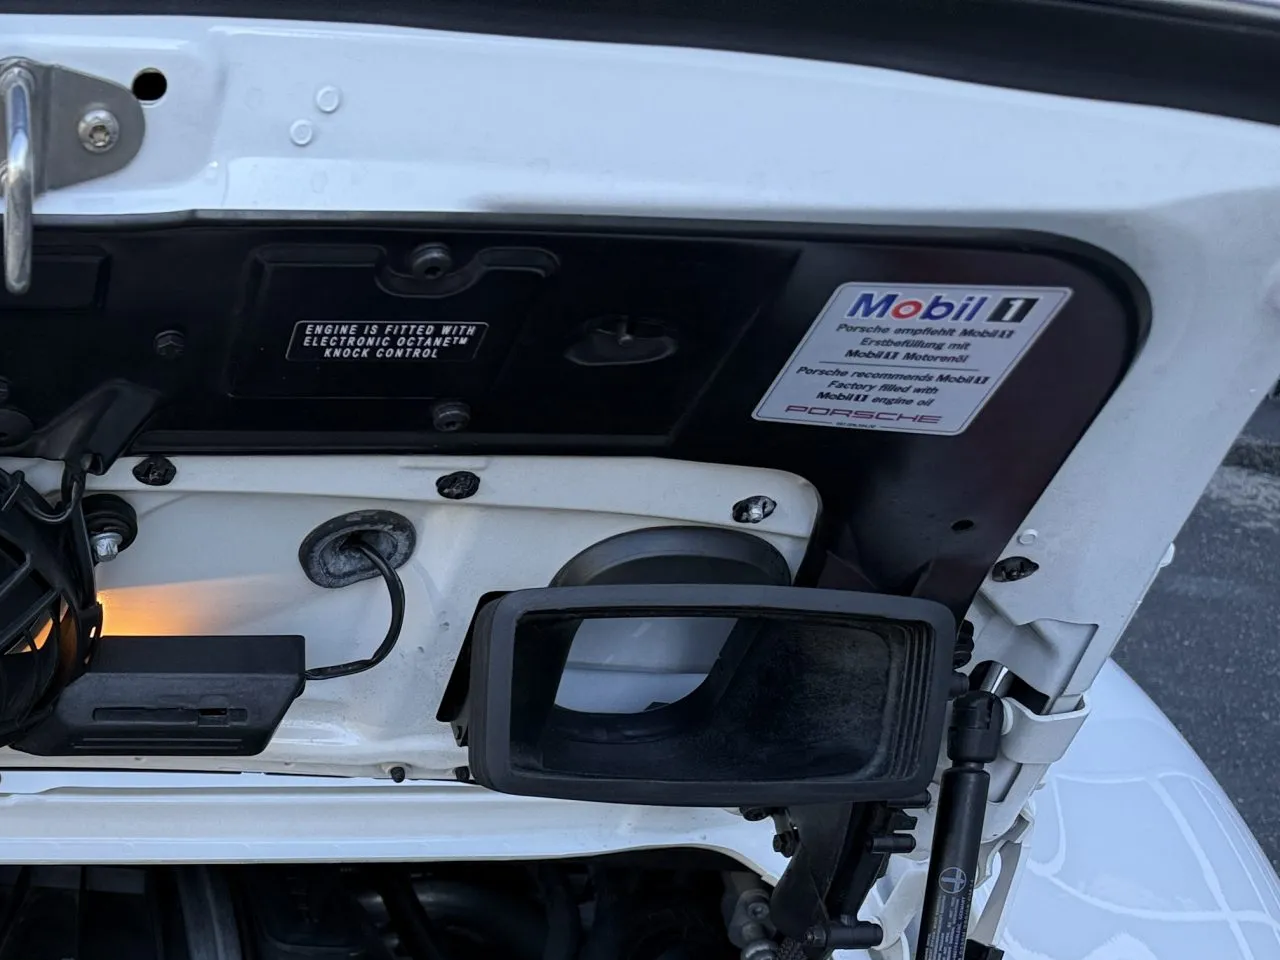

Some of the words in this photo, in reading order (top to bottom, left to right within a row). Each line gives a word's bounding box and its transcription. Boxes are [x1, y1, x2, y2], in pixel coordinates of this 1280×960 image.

[845, 292, 989, 322] Mobil
[305, 324, 358, 335] ENGINE
[363, 325, 379, 335] IS
[384, 325, 435, 335] FITTED
[441, 325, 477, 336] WITH
[836, 322, 890, 336] Porsche
[894, 326, 956, 338] empfiehlt
[303, 336, 391, 347] ELECTRONIC
[860, 337, 948, 351] Erstbefüllung
[951, 341, 972, 350] mit
[324, 348, 369, 358] KNOCK
[375, 348, 438, 359] CONTROL
[902, 352, 968, 364] Motorenöl
[796, 366, 849, 378] Porsche
[851, 370, 934, 382] recommends
[827, 380, 877, 393] Factory
[878, 383, 911, 394] filled
[913, 386, 939, 395] with
[871, 395, 914, 406] engine
[917, 397, 935, 407] oil
[784, 404, 943, 424] PORSCHE
